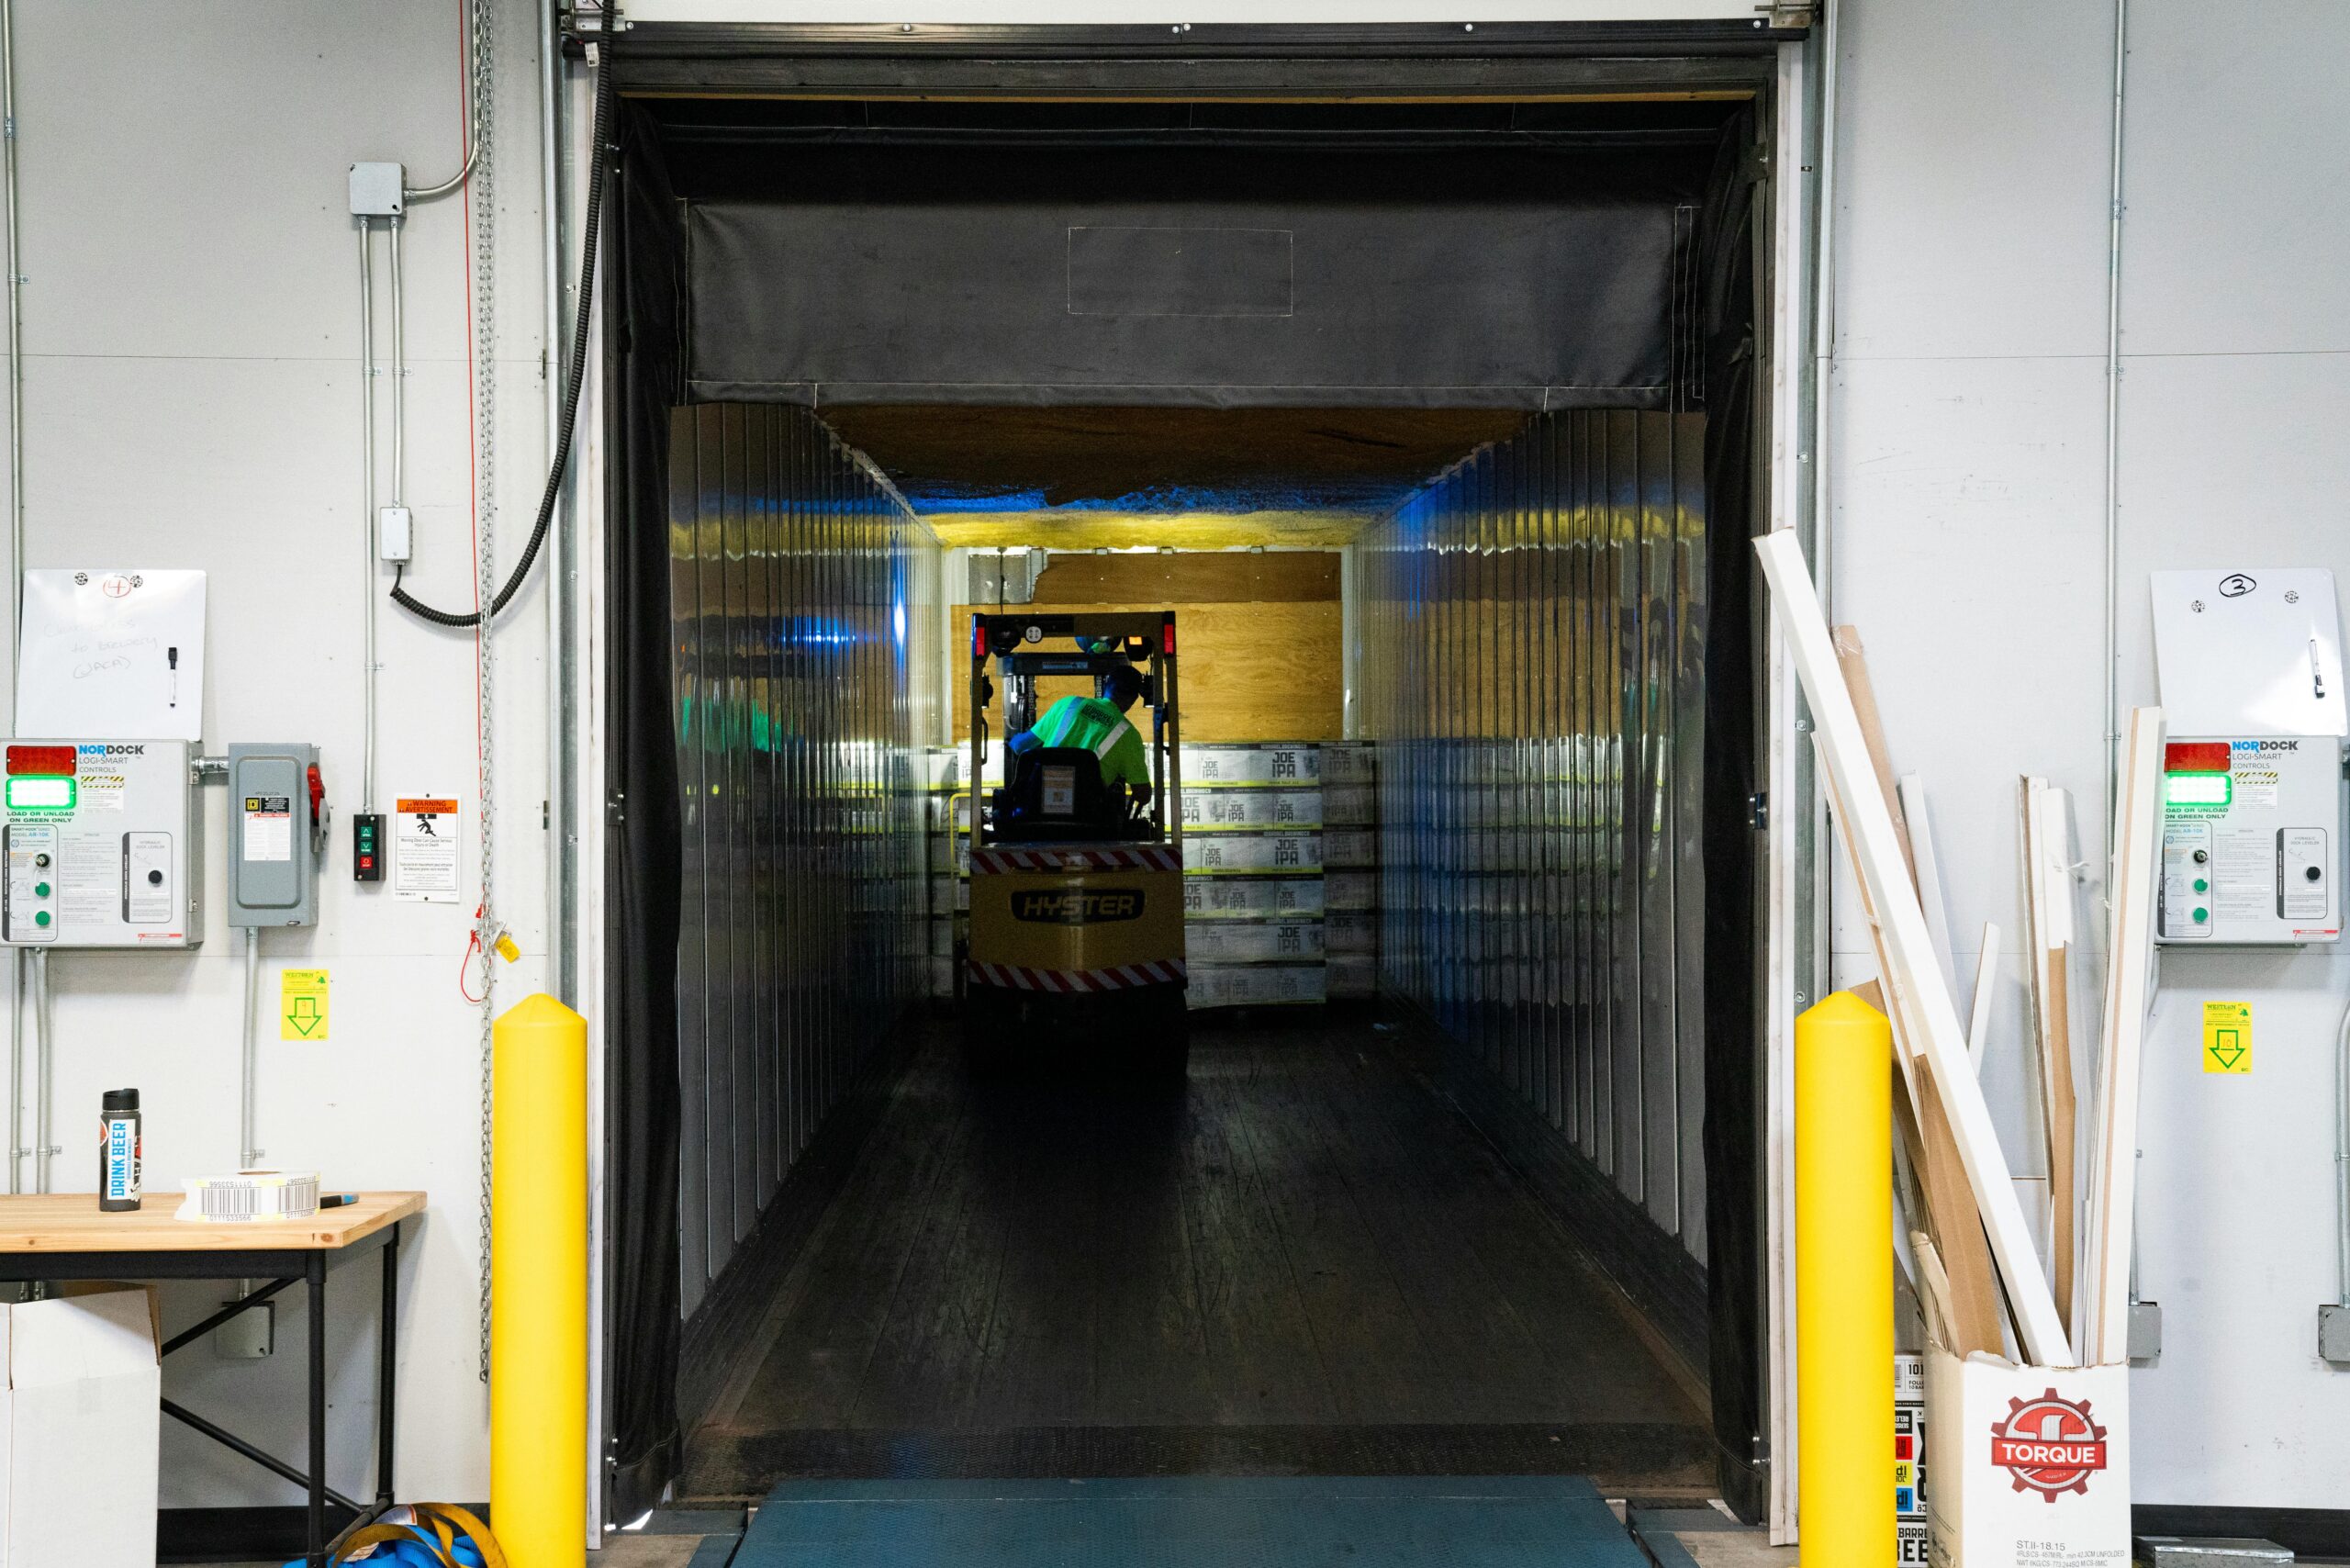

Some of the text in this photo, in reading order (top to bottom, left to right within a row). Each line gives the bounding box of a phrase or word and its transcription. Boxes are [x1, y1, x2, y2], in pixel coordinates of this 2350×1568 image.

[107, 580, 127, 595] 4
[2230, 578, 2246, 596] 3
[78, 745, 144, 756] NORDOCK
[2232, 741, 2299, 753] NORDOCK
[1272, 752, 1295, 763] JOE
[1203, 761, 1218, 769] JOE
[1203, 768, 1218, 778] IPA
[1272, 763, 1295, 778] IPA
[1277, 803, 1293, 812] JOE
[1228, 812, 1245, 822] IPA
[1277, 812, 1293, 822] IPA
[1275, 839, 1299, 850] JOE
[1205, 848, 1221, 857] JOE
[1275, 850, 1299, 865] IPA
[1205, 857, 1222, 866] IPA
[1229, 891, 1246, 900] JOE
[1279, 890, 1295, 900] JOE
[1024, 895, 1136, 916] HYSTER
[1230, 900, 1246, 910] IPA
[1280, 900, 1295, 909] IPA
[1278, 926, 1300, 938] JOE
[1277, 938, 1301, 952] IPA
[111, 1123, 127, 1197] DRINK BEER
[208, 1181, 252, 1189] 0111533566
[2001, 1443, 2096, 1464] TORQUE
[2097, 1550, 2125, 1558] UNFOLDED
